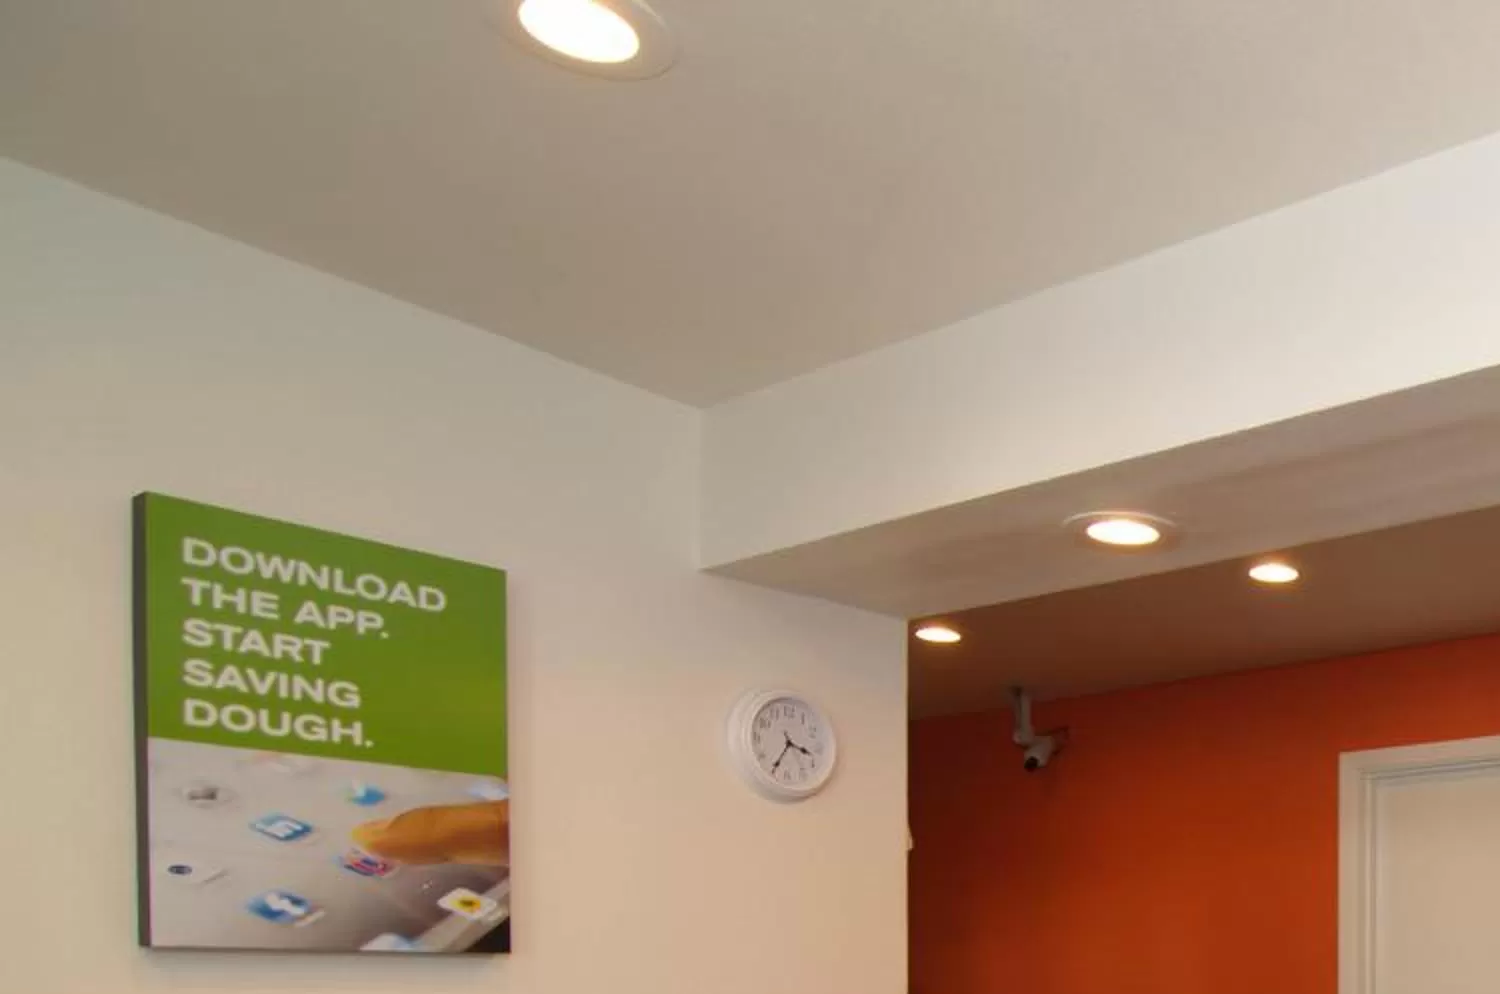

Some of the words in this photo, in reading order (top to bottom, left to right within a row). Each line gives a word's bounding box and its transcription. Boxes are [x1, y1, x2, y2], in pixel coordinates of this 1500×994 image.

[182, 537, 447, 612] DOWNLOAD
[181, 577, 280, 620] THE
[294, 601, 390, 638] APP.
[182, 618, 331, 665] START
[182, 658, 361, 709] SAVING
[183, 698, 374, 748] DOUGH.
